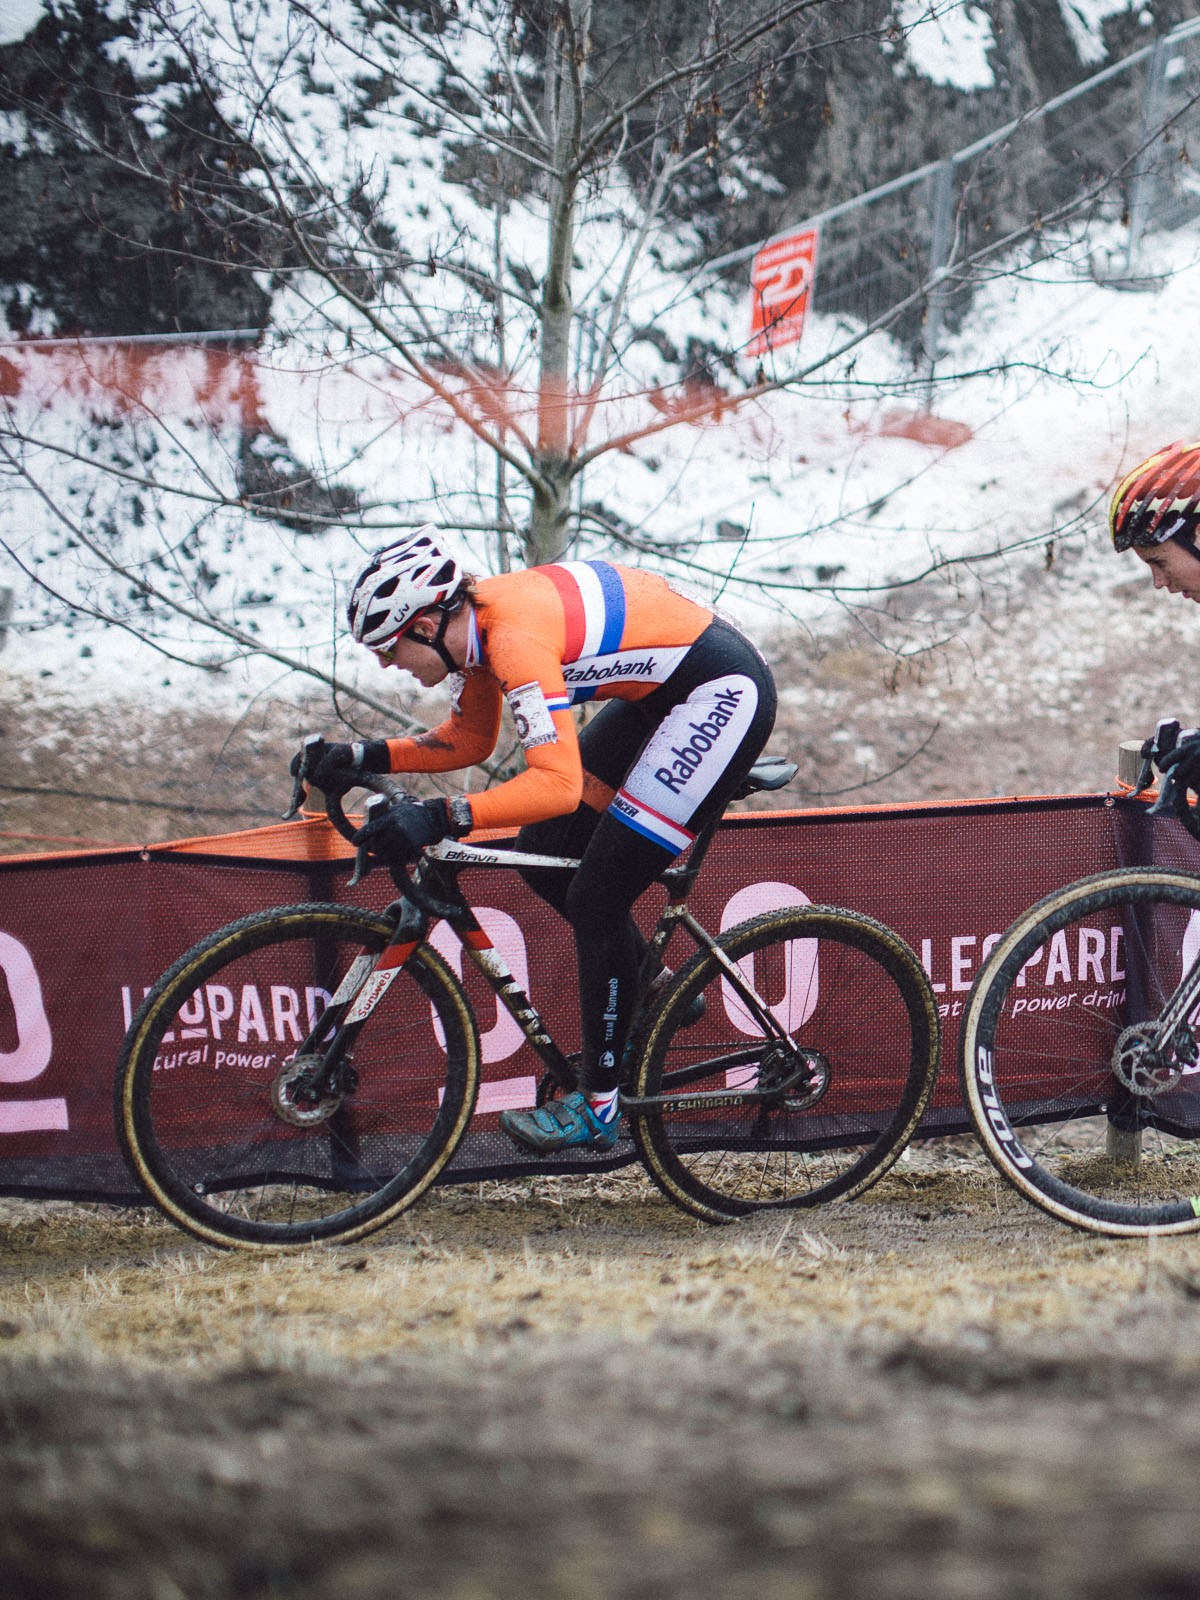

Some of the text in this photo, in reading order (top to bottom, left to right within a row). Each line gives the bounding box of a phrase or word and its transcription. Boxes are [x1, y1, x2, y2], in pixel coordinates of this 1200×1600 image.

[564, 657, 657, 682] Rabobank
[655, 688, 744, 795] Rabobank
[444, 850, 499, 864] BRAVA
[358, 972, 392, 1018] Sunweb
[1011, 992, 1078, 1019] power
[121, 984, 338, 1043] LOPARD
[606, 977, 619, 1041] TEAM Sunweb
[214, 1050, 277, 1070] power
[677, 1095, 744, 1112] SHIMANO
